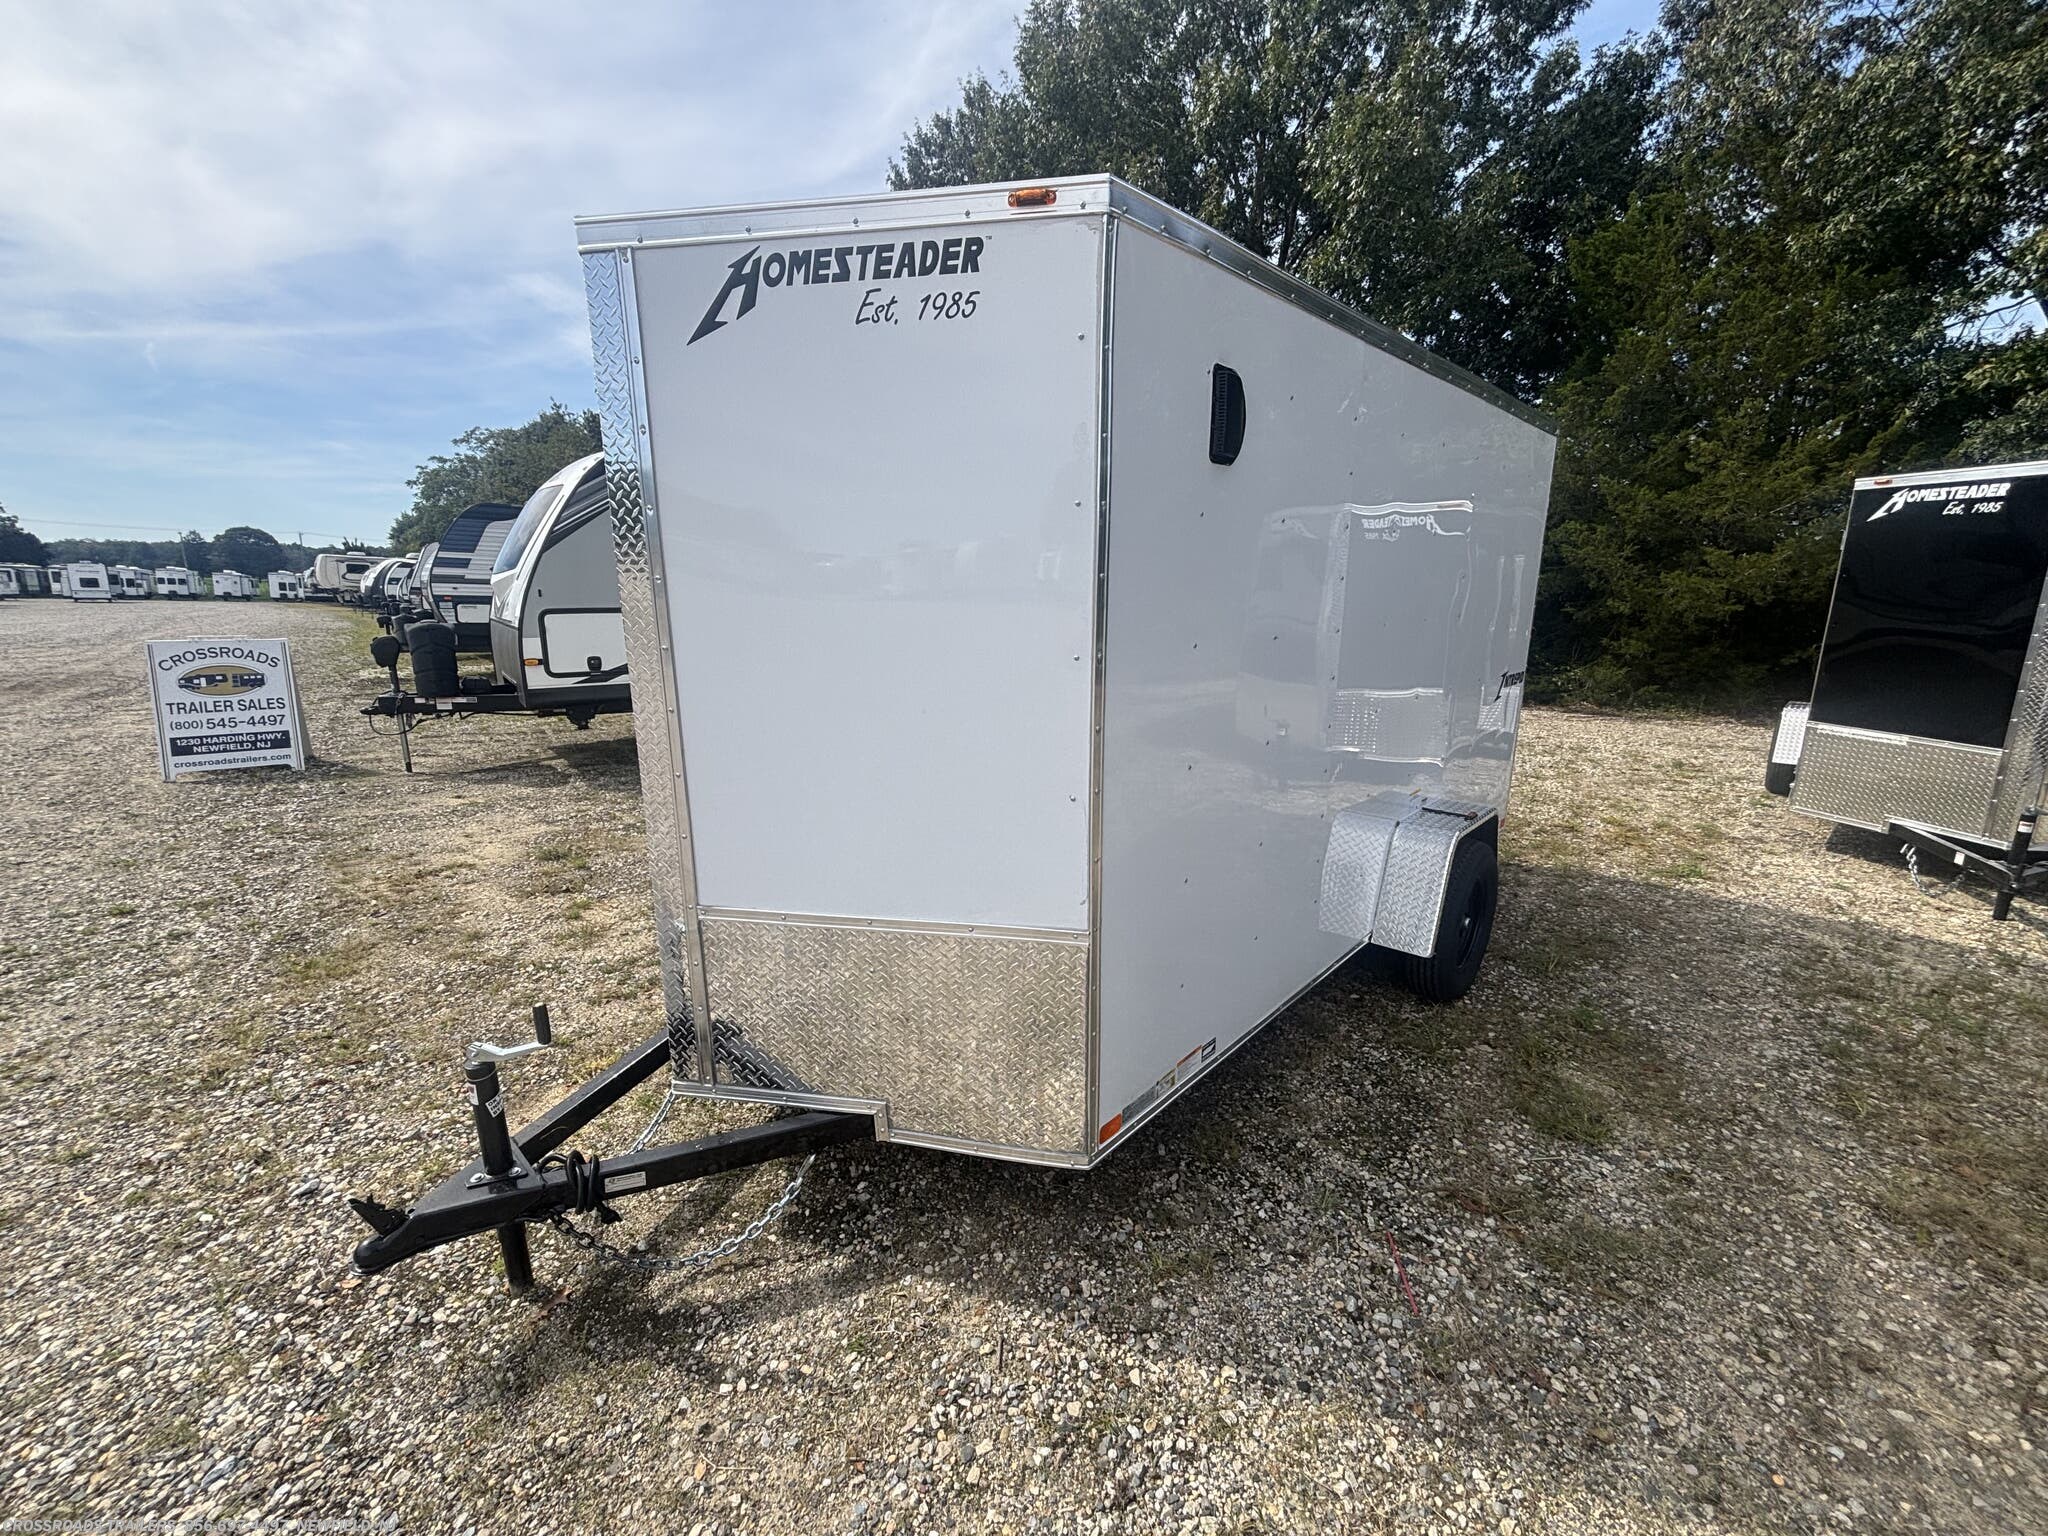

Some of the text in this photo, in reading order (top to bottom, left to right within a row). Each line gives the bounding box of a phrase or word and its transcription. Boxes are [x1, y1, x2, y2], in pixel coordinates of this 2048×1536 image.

[686, 236, 984, 346] HOMESTEADER
[919, 291, 981, 320] 1985
[1866, 483, 2011, 522] HOMESTEADER
[1971, 501, 2004, 514] 1985
[158, 646, 280, 671] CROSSROADS
[166, 697, 286, 714] TRAILER SALES
[170, 714, 286, 731] (800) 545-4497
[176, 732, 286, 746] 1230 HARDING HWY.
[257, 741, 271, 749] NJ
[174, 754, 291, 768] crossroadstrailers.com
